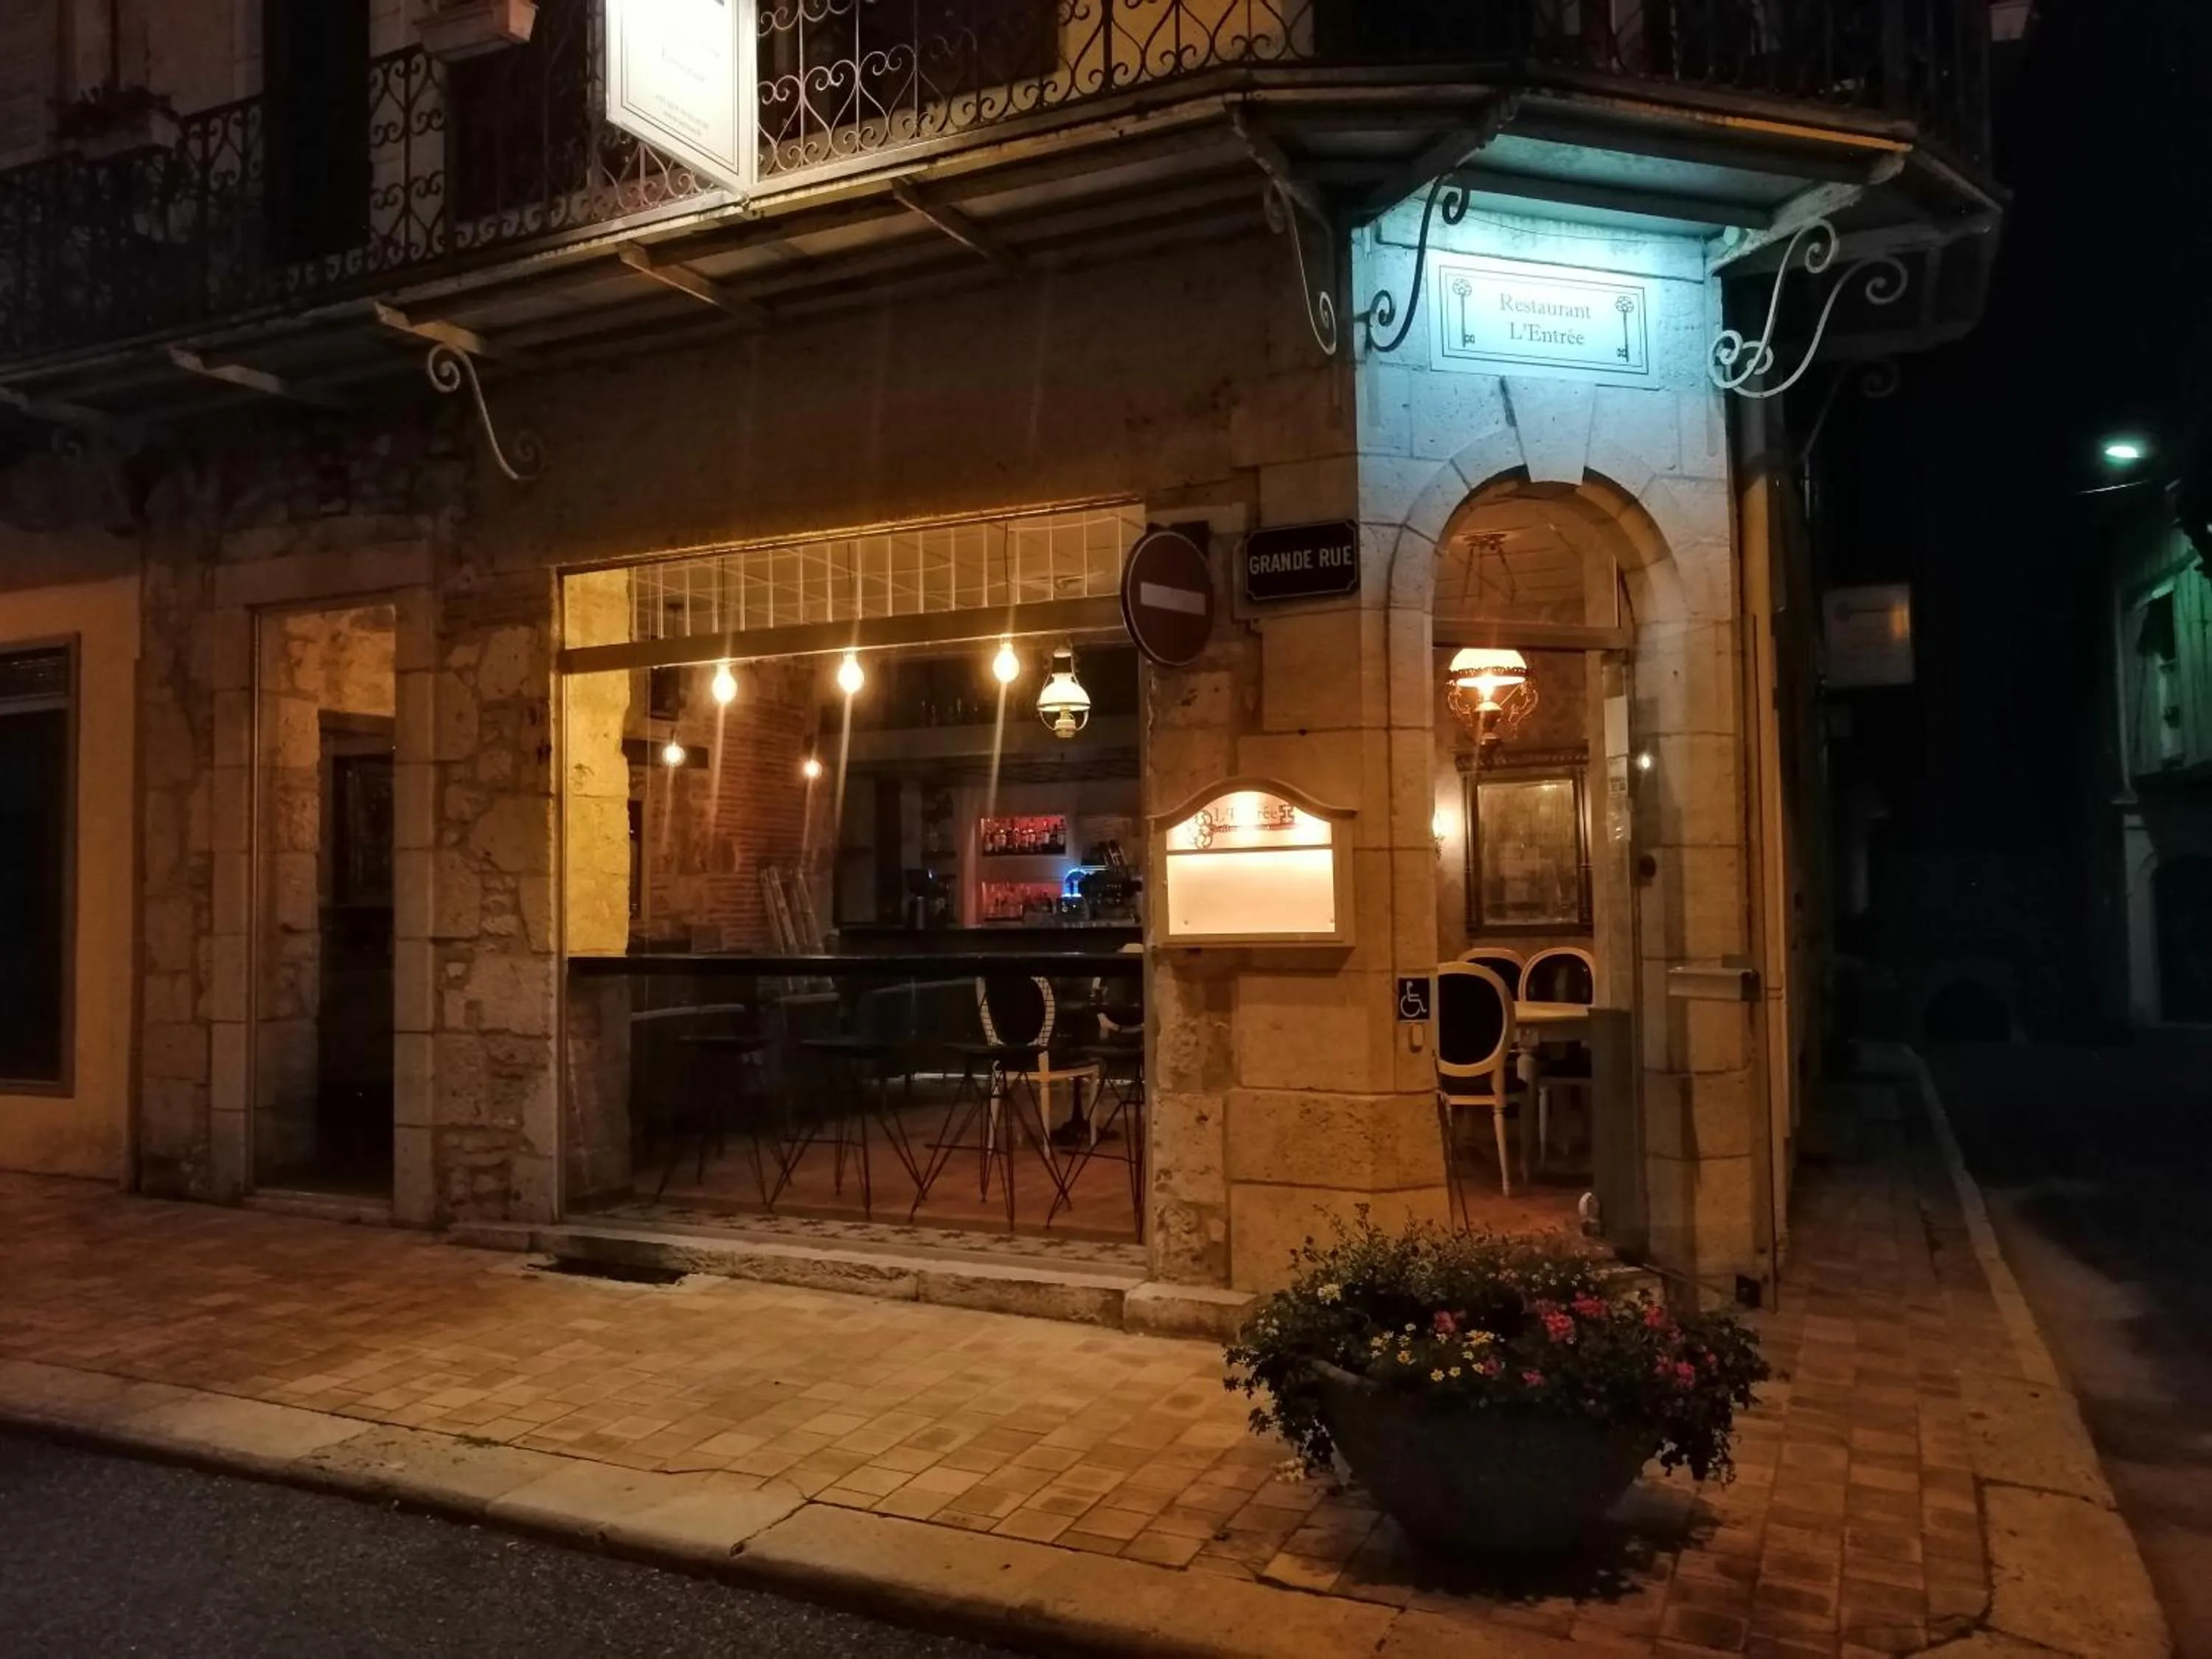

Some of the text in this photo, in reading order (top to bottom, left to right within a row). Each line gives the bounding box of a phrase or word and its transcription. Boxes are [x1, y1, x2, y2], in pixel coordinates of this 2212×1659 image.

[1500, 293, 1591, 319] Restaurant
[1510, 322, 1585, 345] L'Entrée
[1249, 545, 1353, 574] GRANDE RUE
